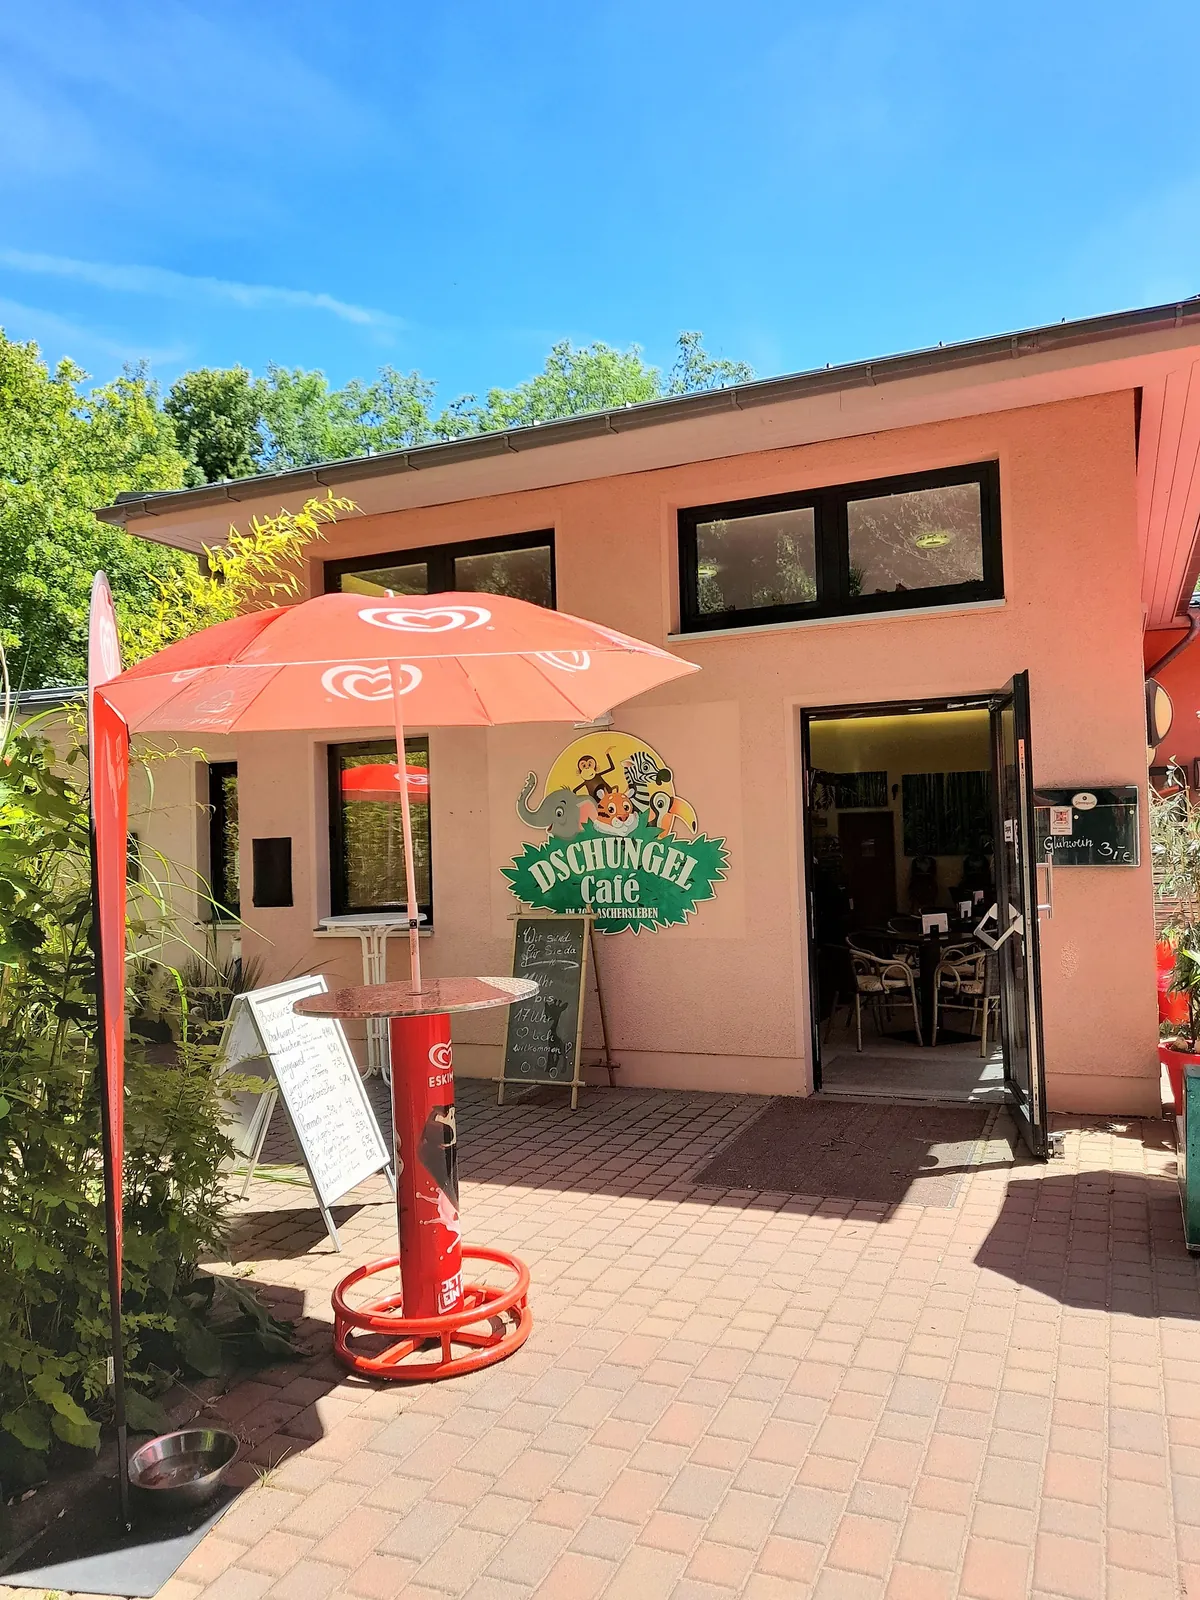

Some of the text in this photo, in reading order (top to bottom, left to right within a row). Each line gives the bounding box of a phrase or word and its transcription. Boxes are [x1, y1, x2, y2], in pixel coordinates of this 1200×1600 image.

[528, 837, 698, 893] DSCHUNGEL
[580, 873, 640, 904] Café
[597, 907, 658, 919] ASCHERSLEBEN
[523, 927, 572, 944] Wir sind
[534, 994, 555, 1004] bis
